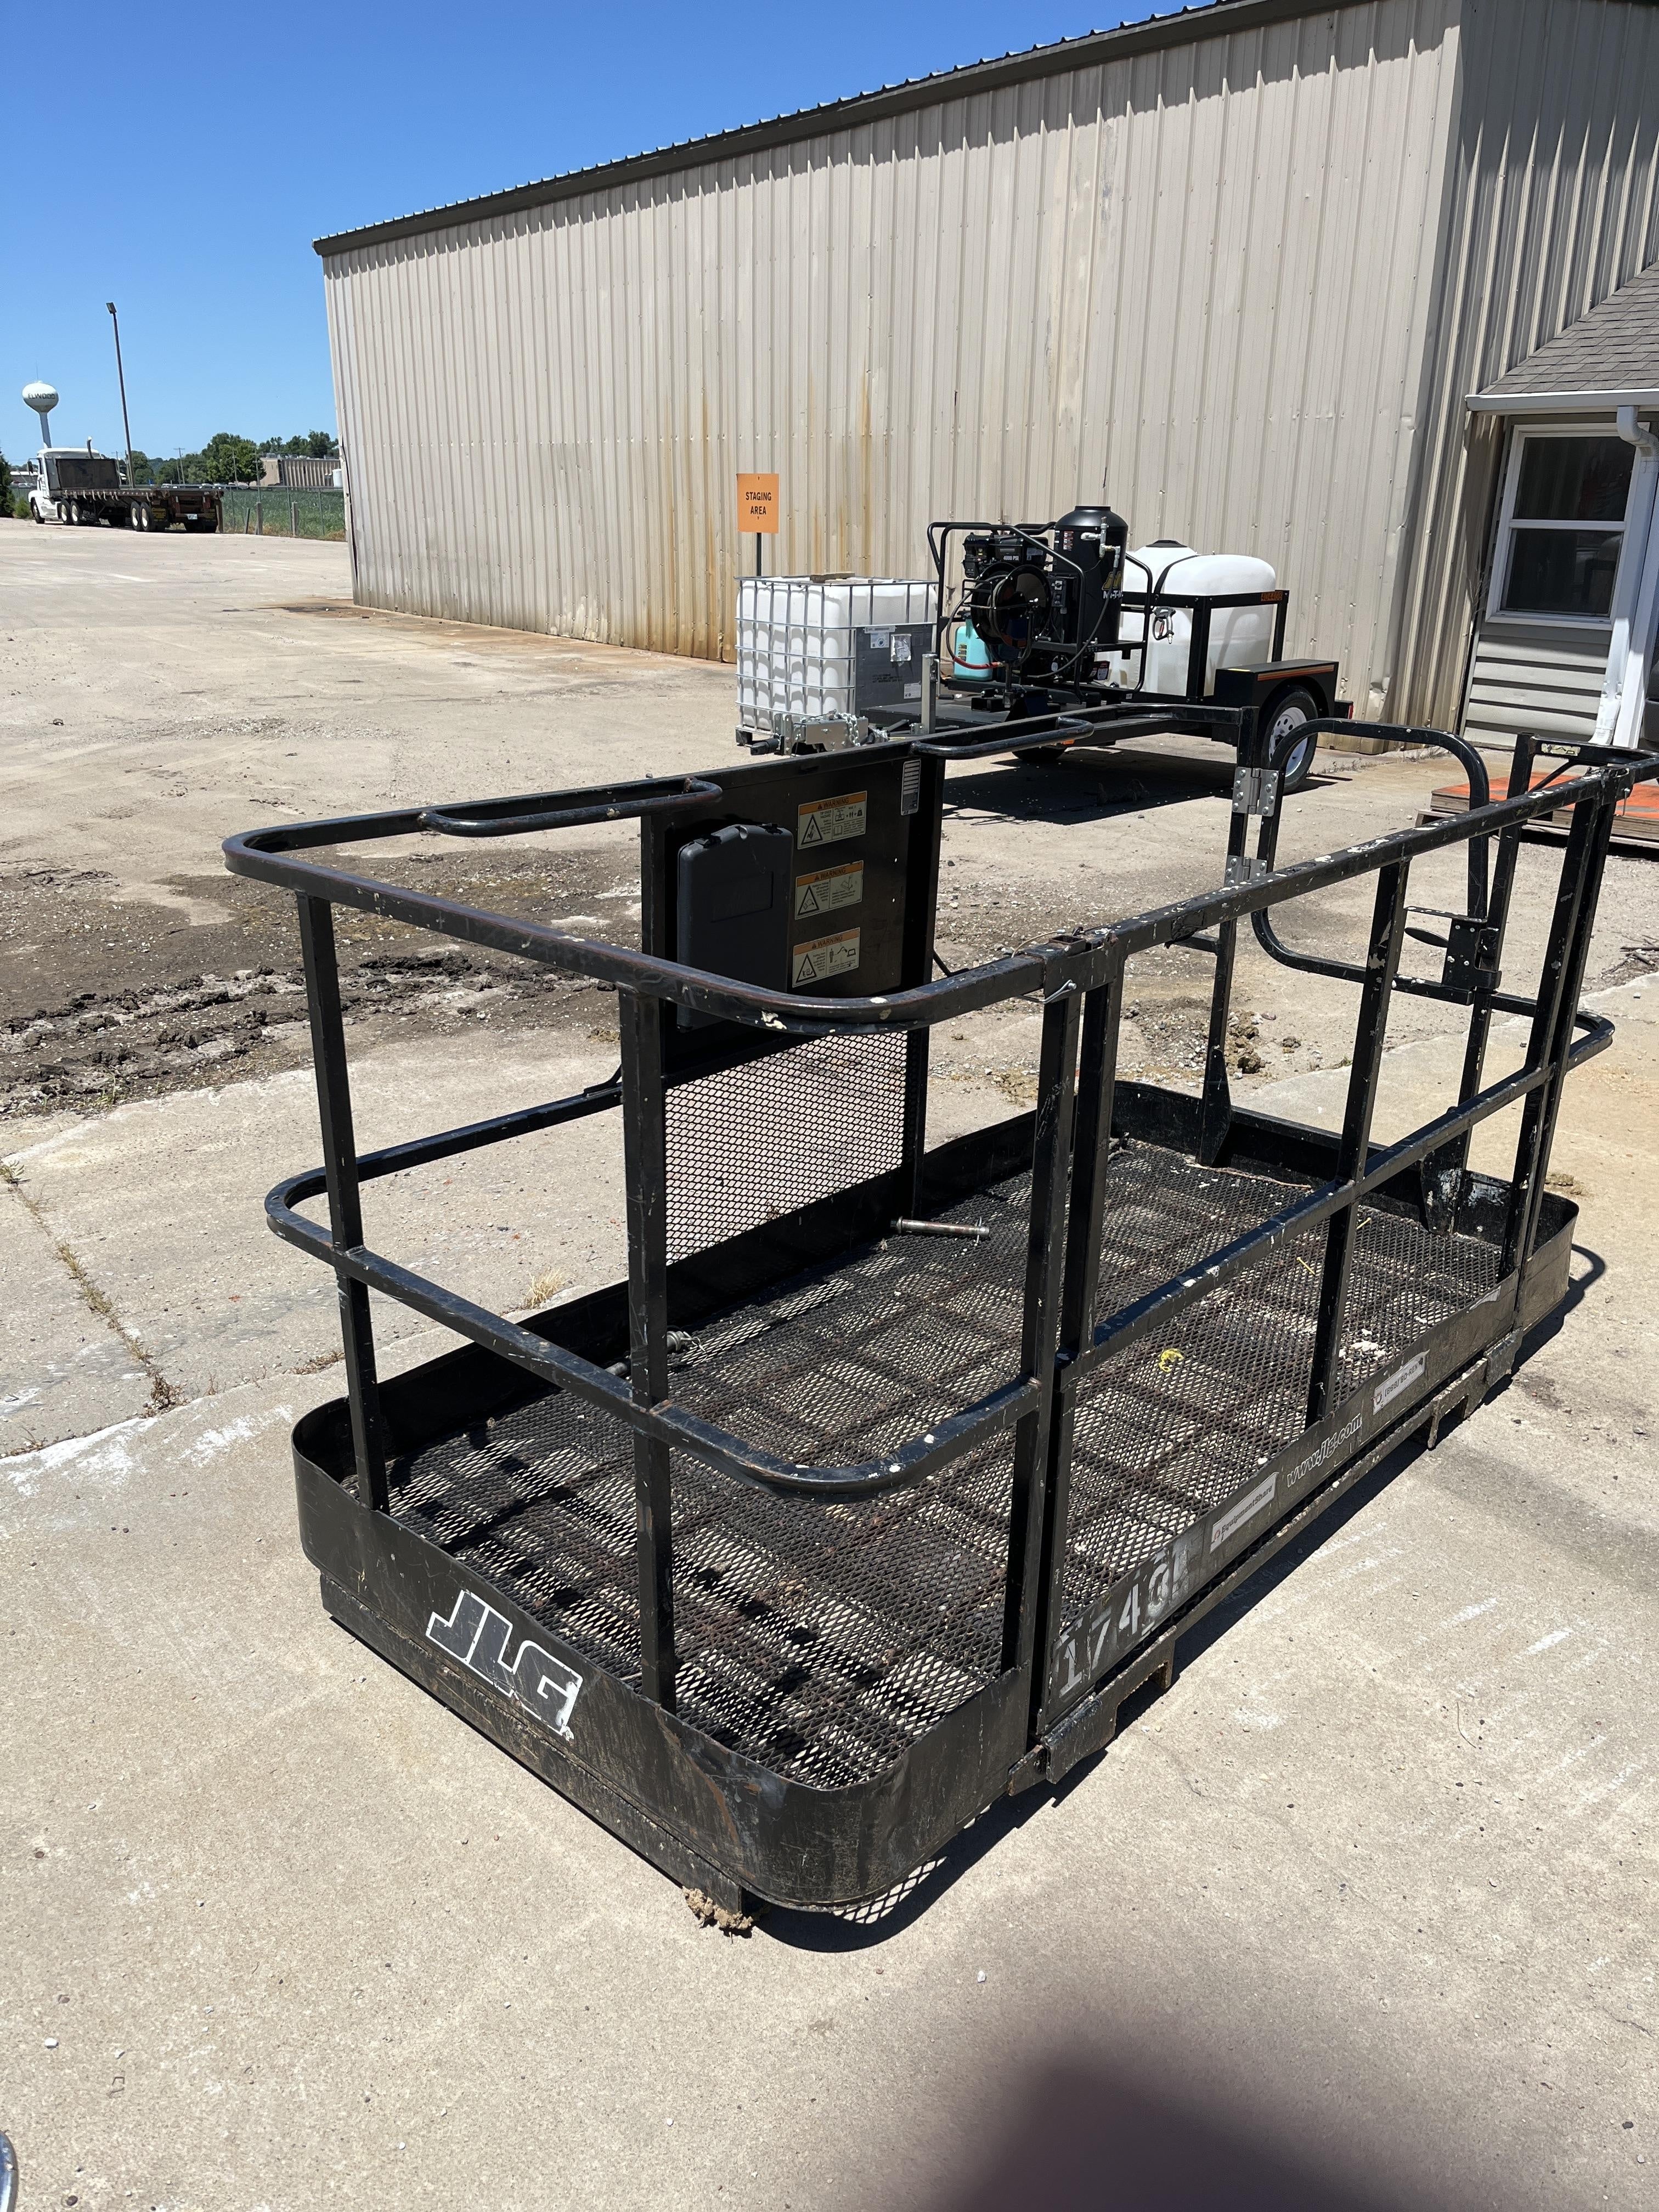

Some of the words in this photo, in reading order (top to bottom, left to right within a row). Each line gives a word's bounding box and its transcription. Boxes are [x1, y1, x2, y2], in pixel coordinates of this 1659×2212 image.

[746, 492, 772, 501] STAGING
[750, 506, 766, 515] AREA
[823, 797, 849, 809] WARNING
[820, 867, 847, 880] WARNING
[817, 934, 843, 948] WARNING
[1286, 1413, 1363, 1488] www.jlg.com
[1221, 1485, 1273, 1534] EquipmentShare
[426, 1589, 583, 1736] JLG
